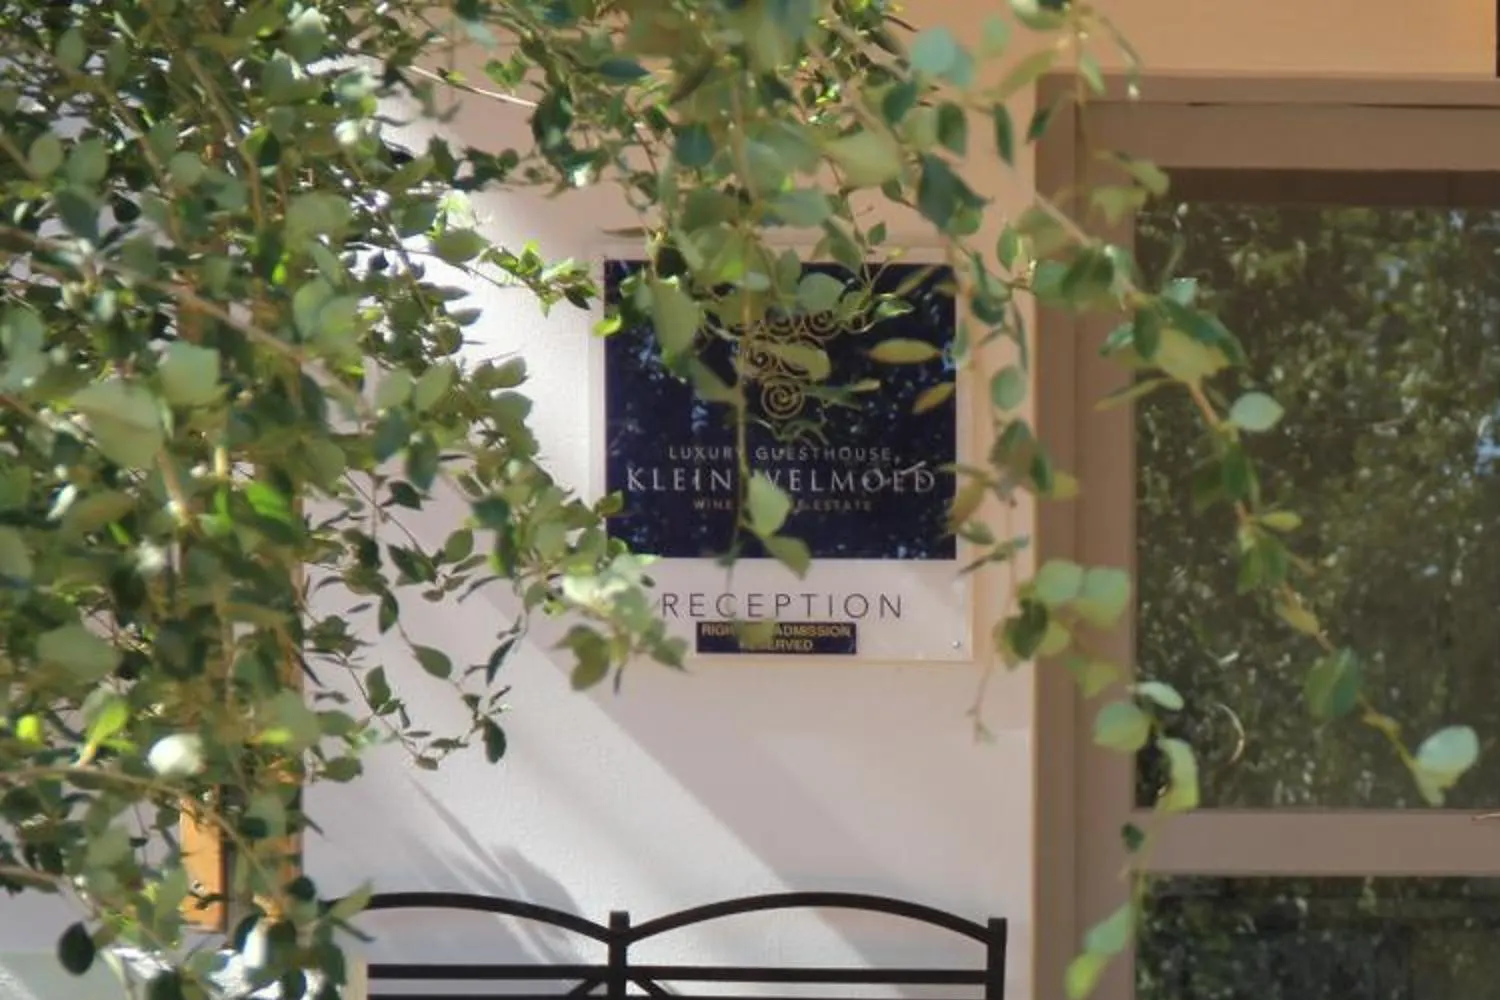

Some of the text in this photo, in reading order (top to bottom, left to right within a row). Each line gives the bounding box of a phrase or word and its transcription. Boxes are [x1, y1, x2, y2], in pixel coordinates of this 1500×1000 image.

[669, 446, 742, 460] LUXUR
[626, 467, 732, 491] KLEIN
[661, 593, 901, 618] RECEPTION
